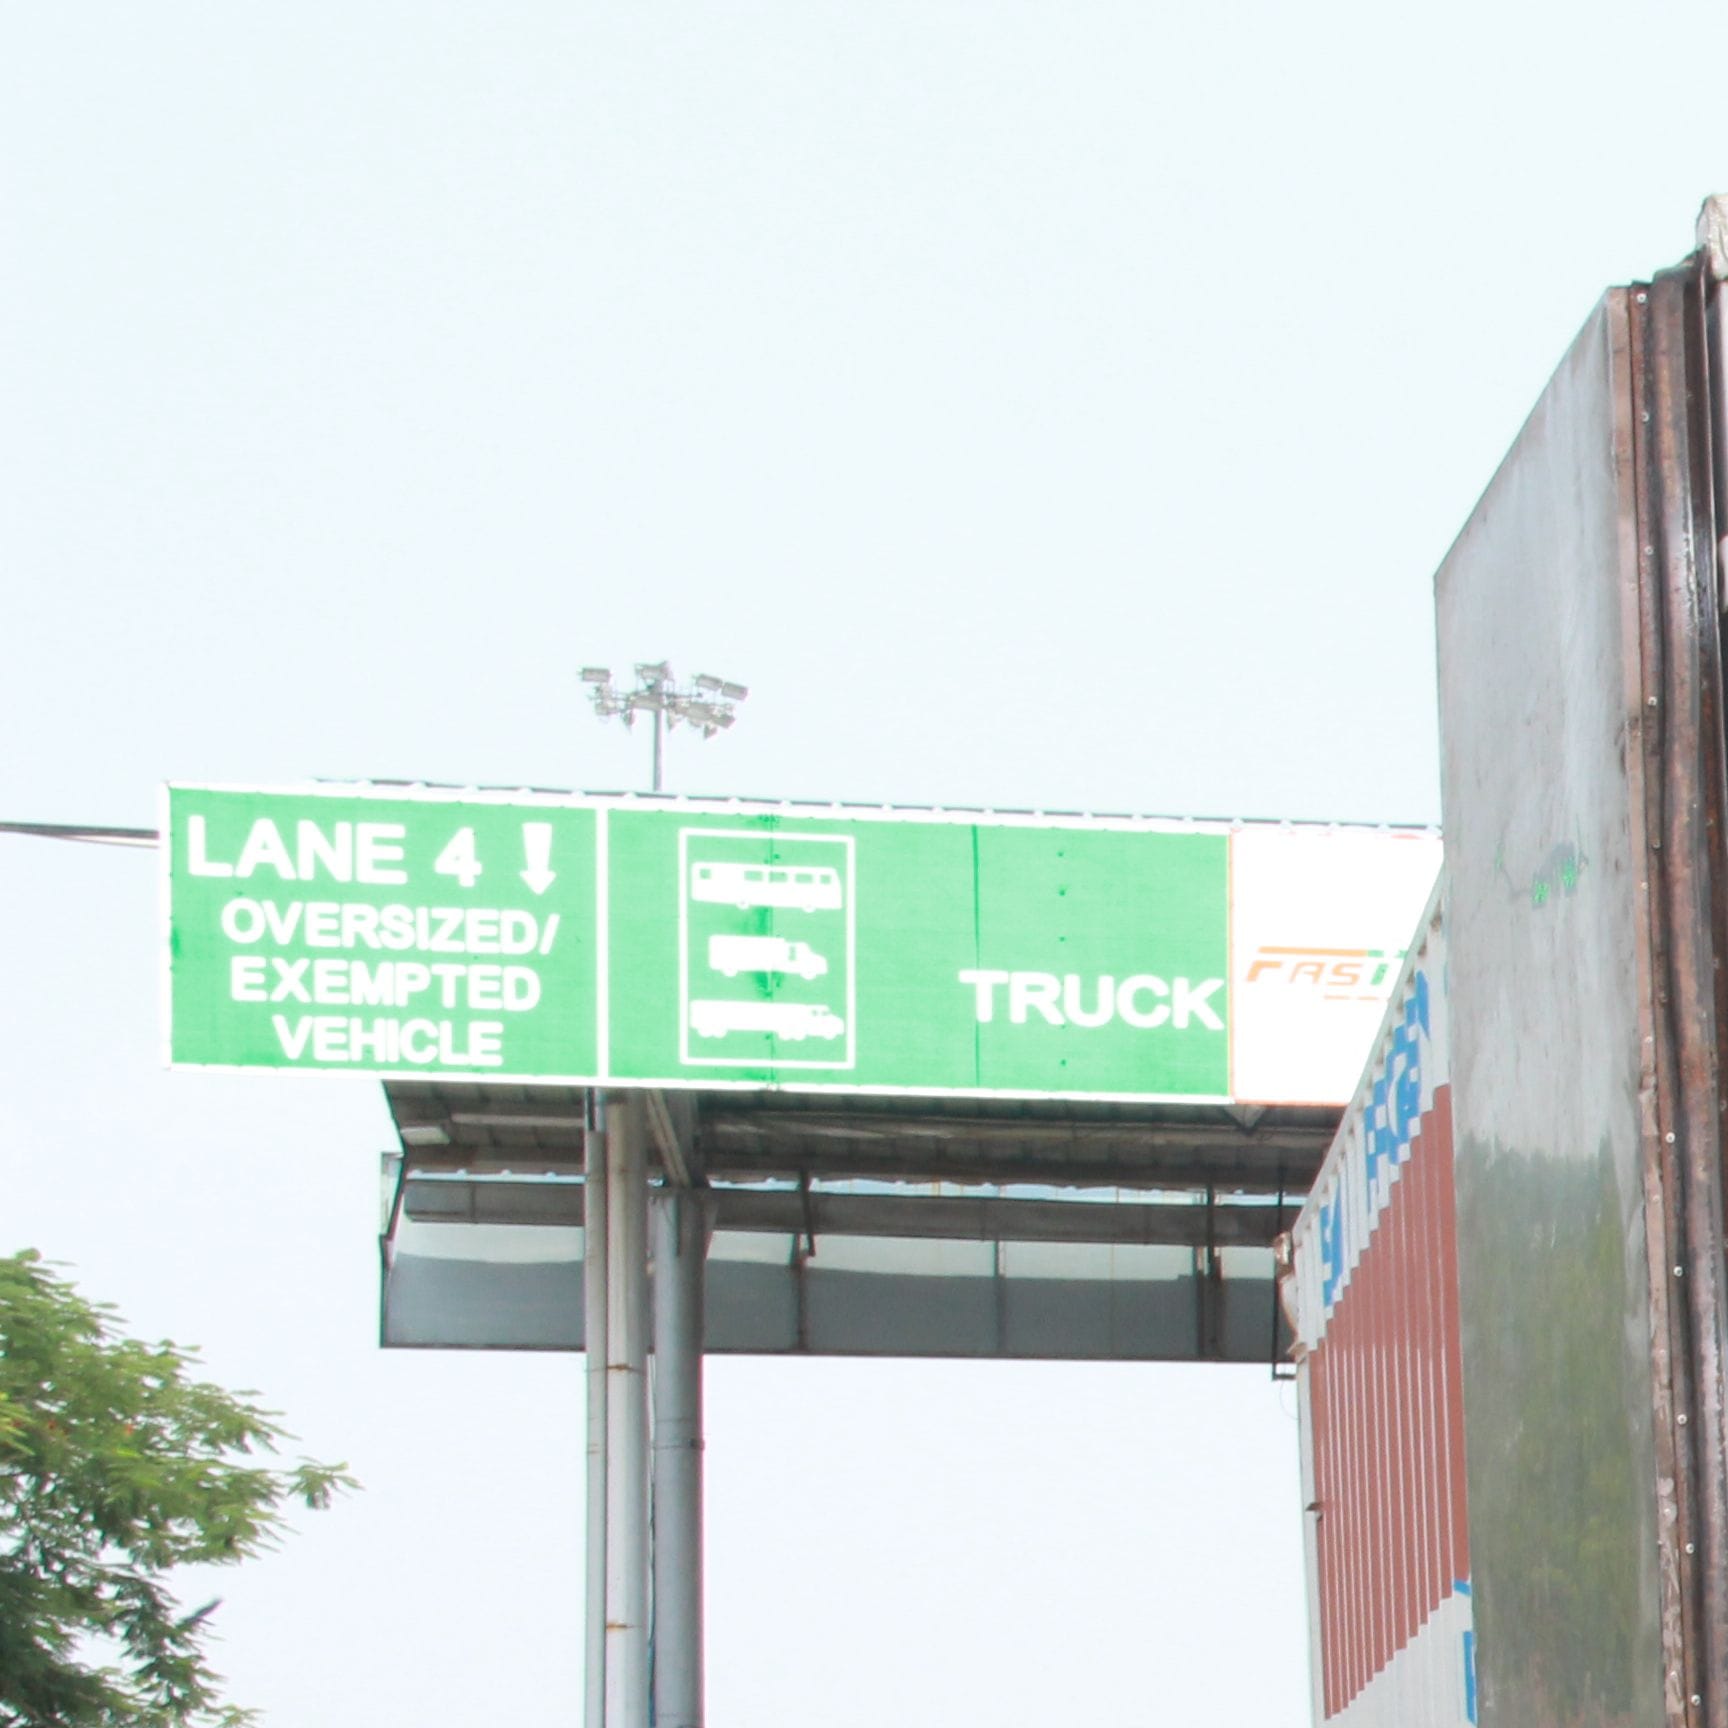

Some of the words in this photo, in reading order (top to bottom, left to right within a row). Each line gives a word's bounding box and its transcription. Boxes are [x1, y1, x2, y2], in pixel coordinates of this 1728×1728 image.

[187, 814, 409, 885] LANE
[433, 826, 483, 888] 4
[221, 898, 560, 955] OVERSIZED/
[229, 955, 542, 1012] EXEMPTED
[957, 968, 1226, 1031] TRUCK
[271, 1014, 506, 1067] VEHICLE
